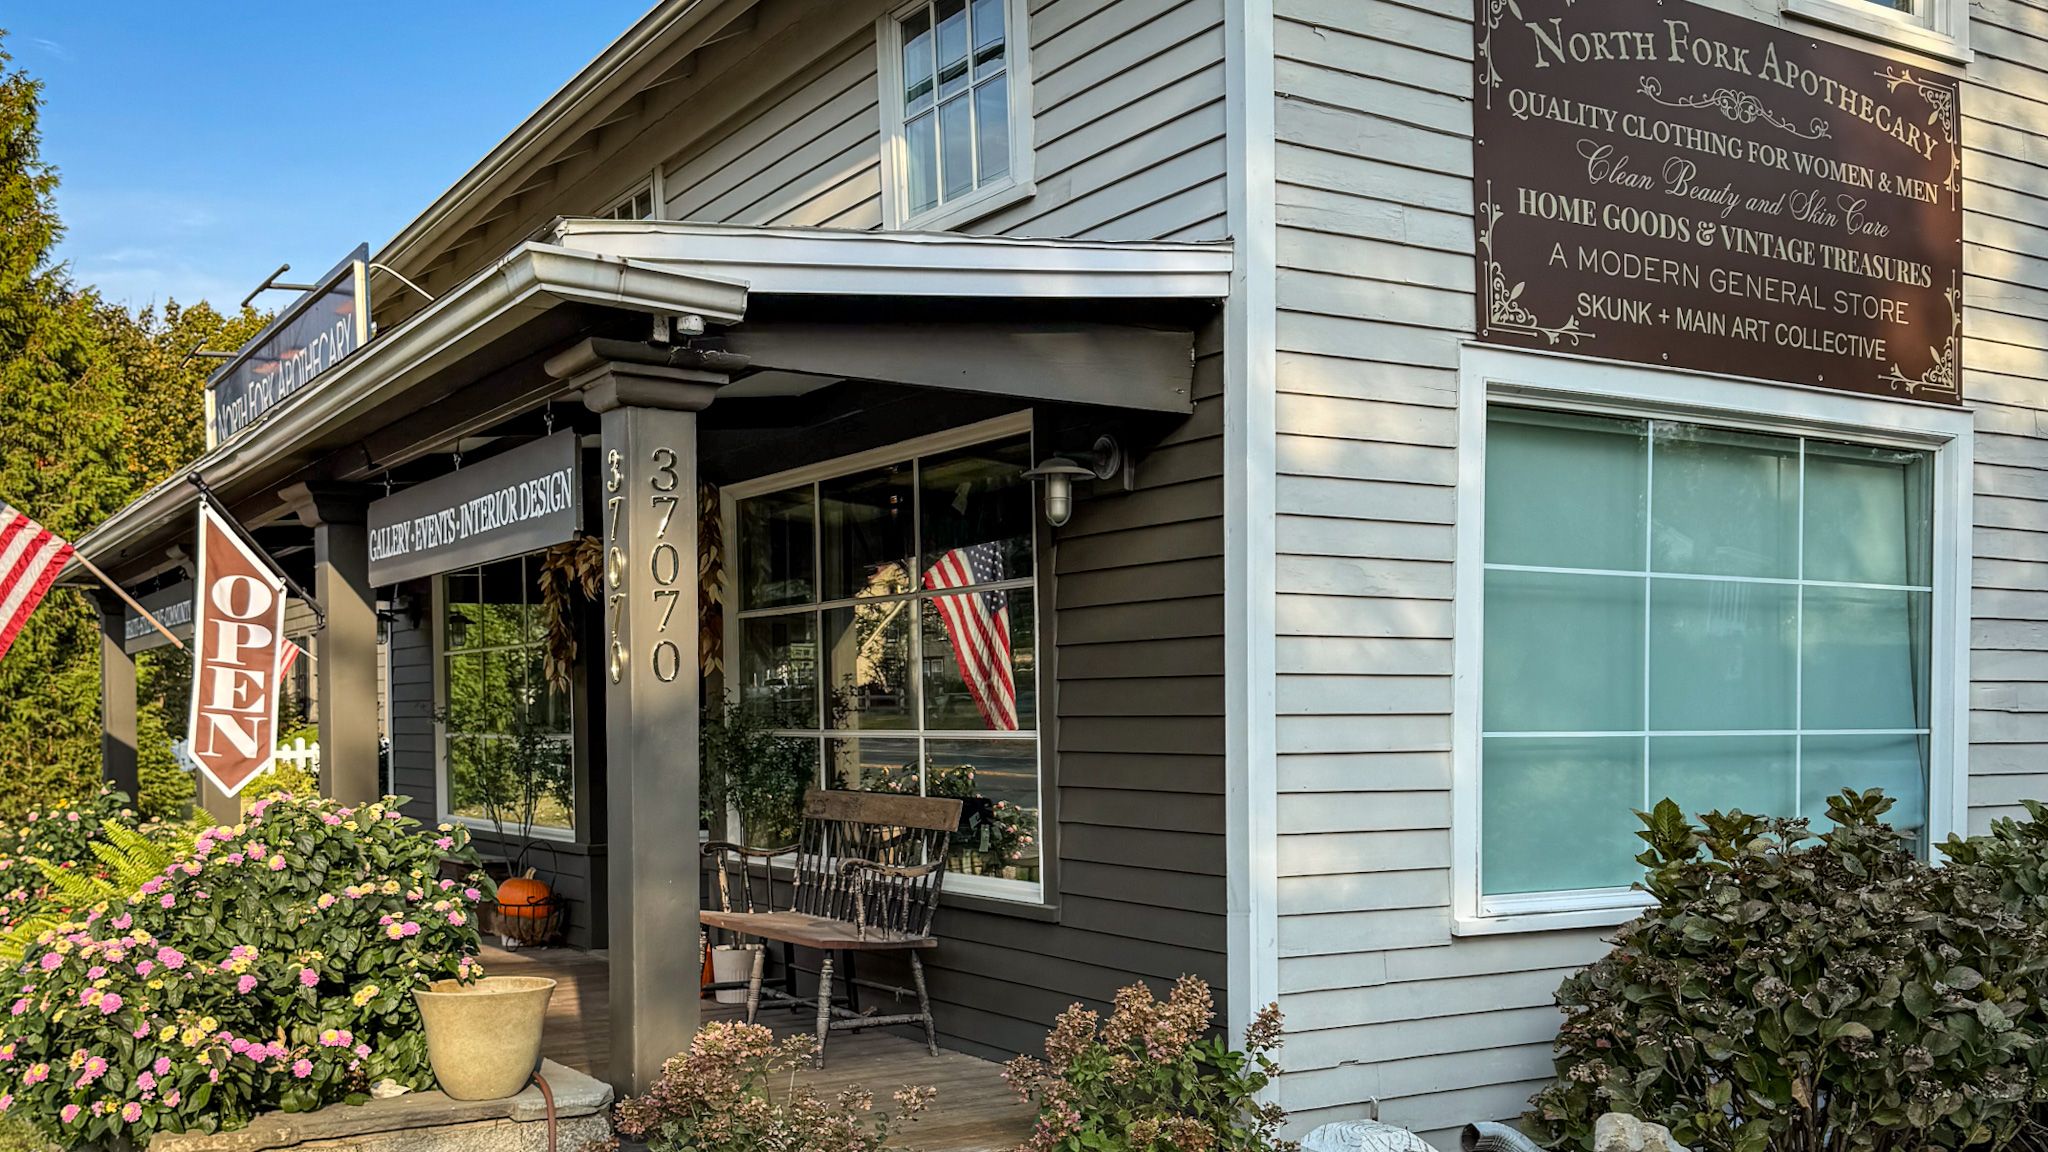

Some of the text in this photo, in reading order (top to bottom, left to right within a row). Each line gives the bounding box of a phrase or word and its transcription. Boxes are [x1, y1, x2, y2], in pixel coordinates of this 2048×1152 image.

[1525, 18, 1938, 161] NORTH FORK APOTHECARY
[1508, 88, 1938, 205] QUALITY CLOTHING FOR WOMEN & MEN
[1576, 139, 1890, 238] Clean Beauty and Skin Care
[1518, 187, 1932, 289] HOME GOODS & VINTAGE TREASURES
[1549, 242, 1910, 325] A MODERN GENERAL STORE
[218, 313, 352, 442] NORTH FORK APOTHECARY
[1577, 292, 1887, 361] SKUNK + MAIN ART COLLECTIVE
[460, 486, 518, 540] INTERIOR
[519, 468, 573, 520] DESIGN
[651, 448, 680, 682] 37070
[198, 574, 273, 758] OPEN
